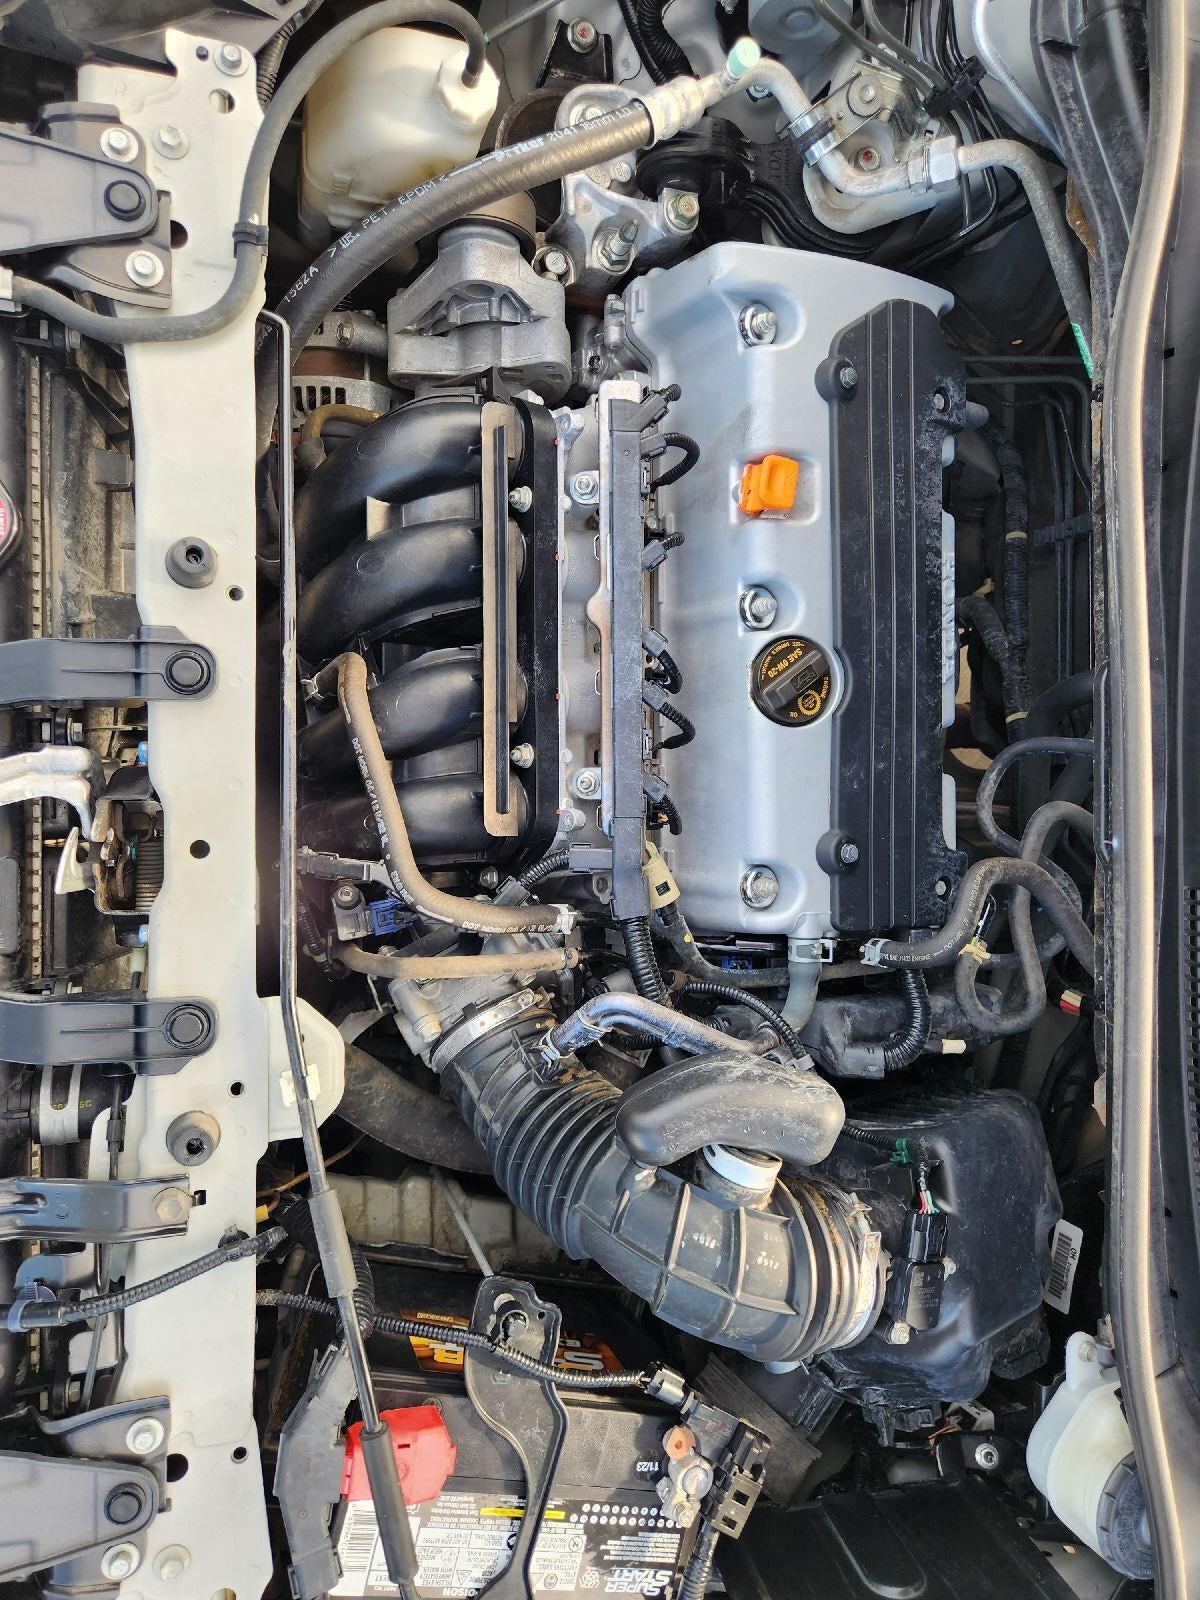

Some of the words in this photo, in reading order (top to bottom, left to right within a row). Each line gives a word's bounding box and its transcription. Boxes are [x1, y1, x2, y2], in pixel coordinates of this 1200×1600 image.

[399, 180, 438, 206] EPDM
[786, 647, 803, 663] SAE
[636, 1462, 659, 1472] 11/23
[606, 1569, 673, 1588] START
[442, 1588, 479, 1597] OISON
[604, 1581, 660, 1597] SUPER
